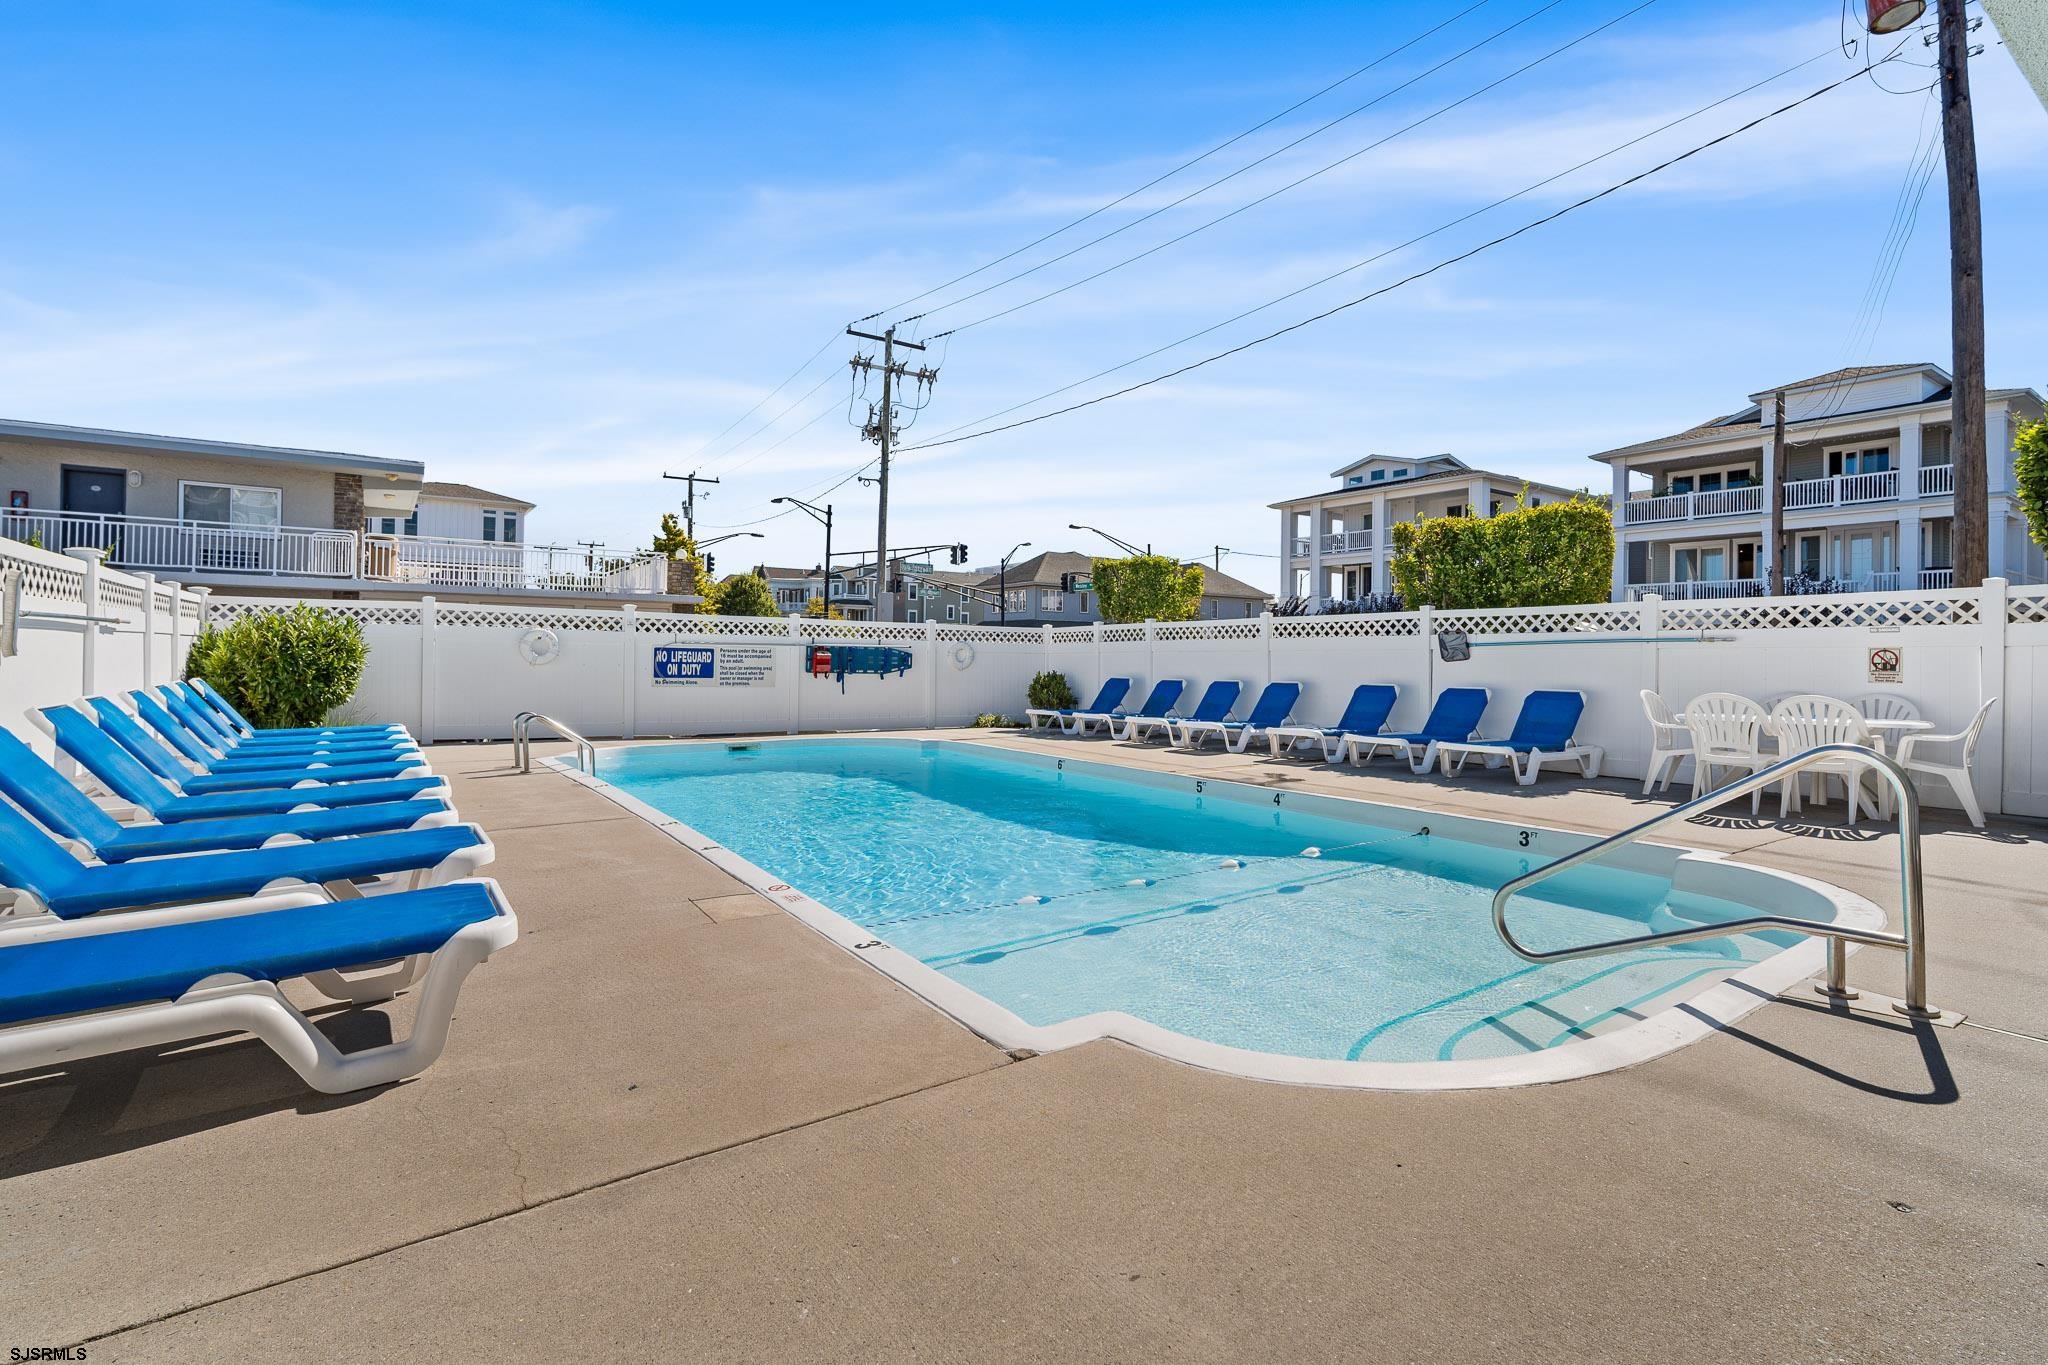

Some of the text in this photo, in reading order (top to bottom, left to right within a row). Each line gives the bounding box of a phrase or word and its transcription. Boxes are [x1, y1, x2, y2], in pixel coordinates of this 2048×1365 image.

[656, 650, 712, 663] NO LIFEGUARD
[667, 663, 701, 675] ON DUTY
